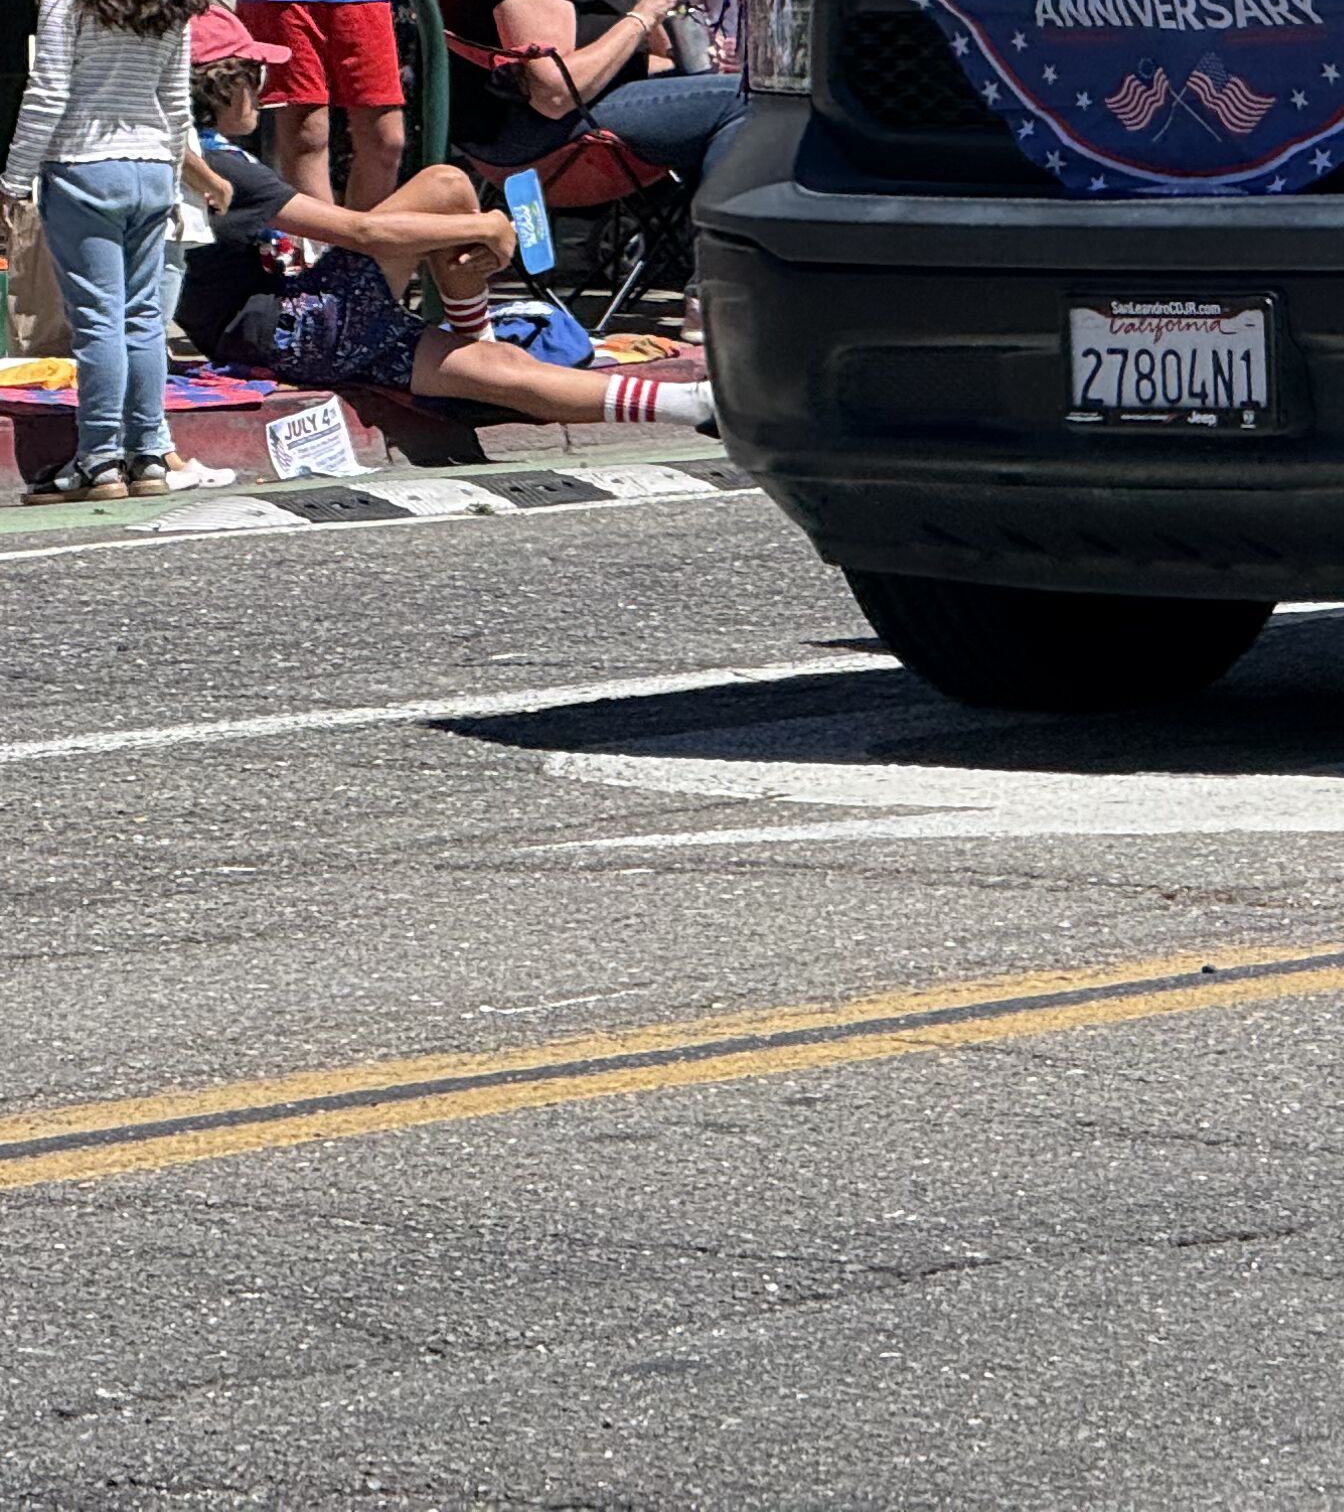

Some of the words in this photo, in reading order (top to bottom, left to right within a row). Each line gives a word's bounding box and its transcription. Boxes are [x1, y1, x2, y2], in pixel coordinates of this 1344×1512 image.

[1109, 317, 1238, 345] California
[1081, 347, 1261, 408] 27804N1
[285, 413, 318, 440] JULY
